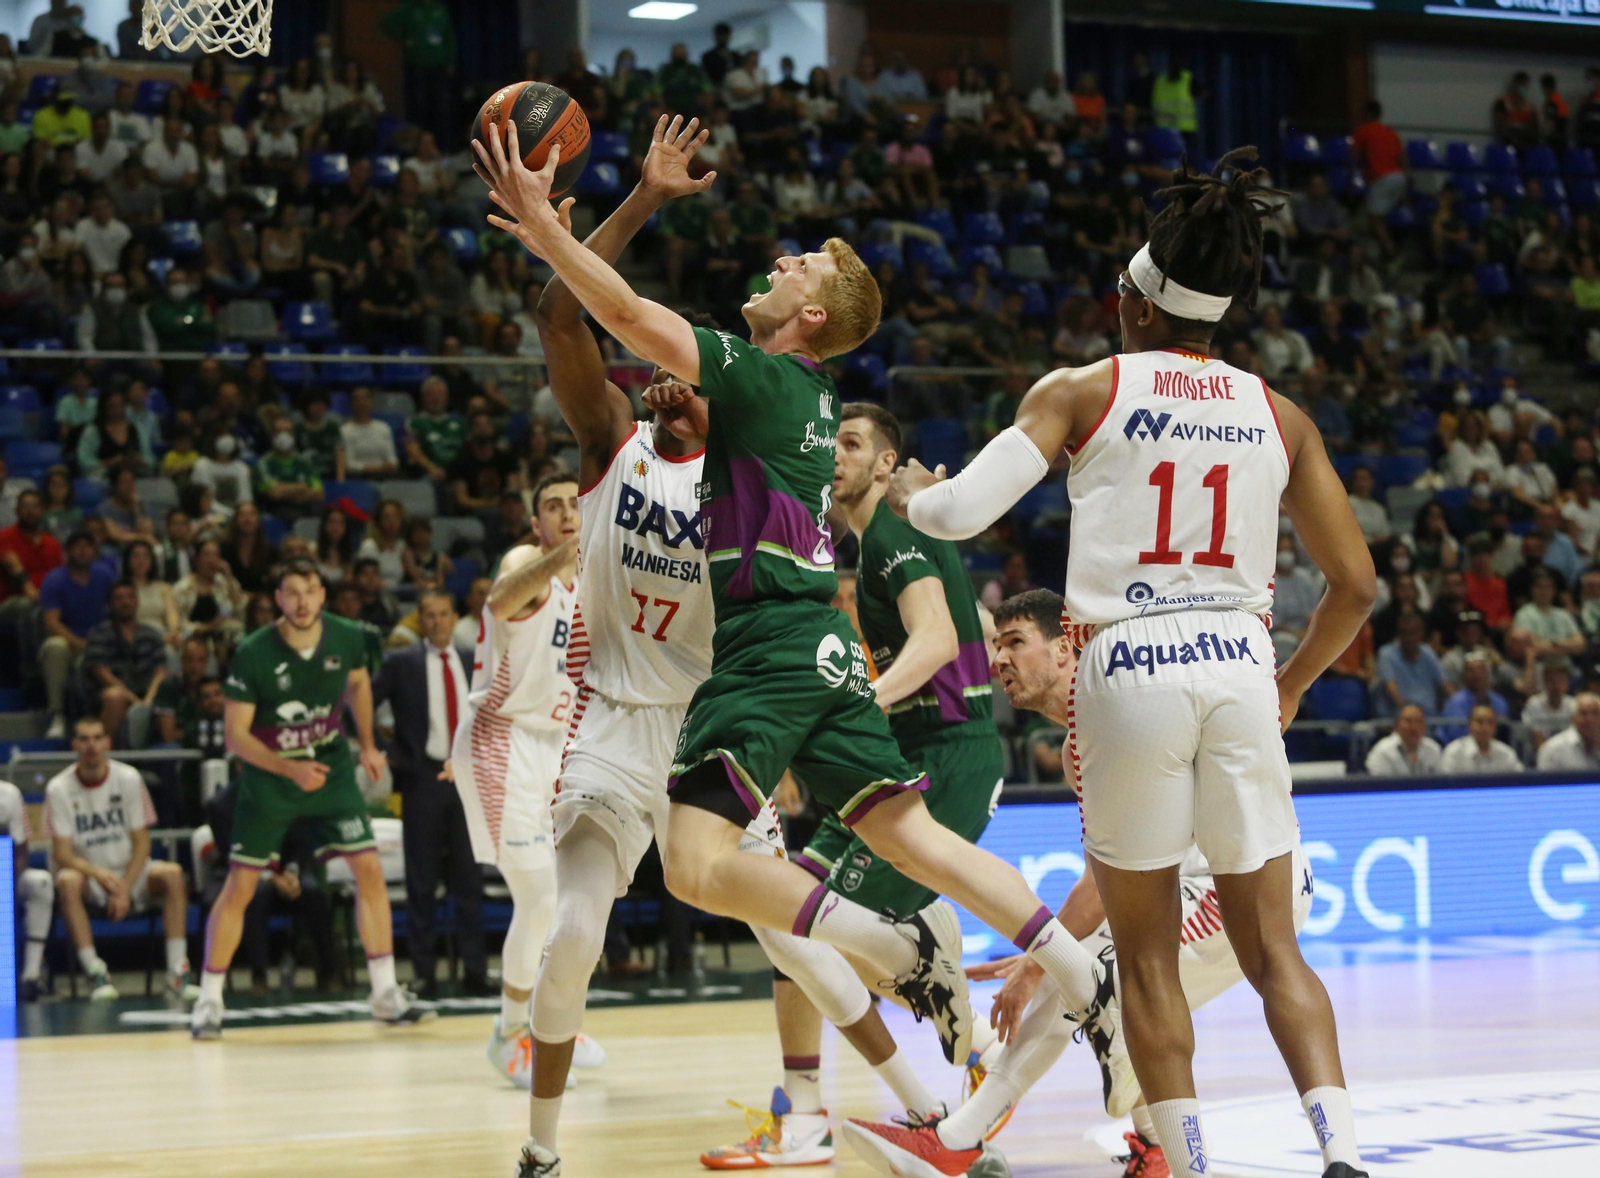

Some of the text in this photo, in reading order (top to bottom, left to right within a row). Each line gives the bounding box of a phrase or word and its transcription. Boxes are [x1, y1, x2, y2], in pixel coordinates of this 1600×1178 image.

[1153, 370, 1235, 401] MONEKE
[1170, 422, 1266, 445] AVINENT
[1138, 461, 1235, 569] 11
[621, 543, 701, 584] MANRESA
[631, 588, 680, 642] 17
[1155, 594, 1216, 607] Manresa
[1105, 632, 1260, 677] Aquaflix
